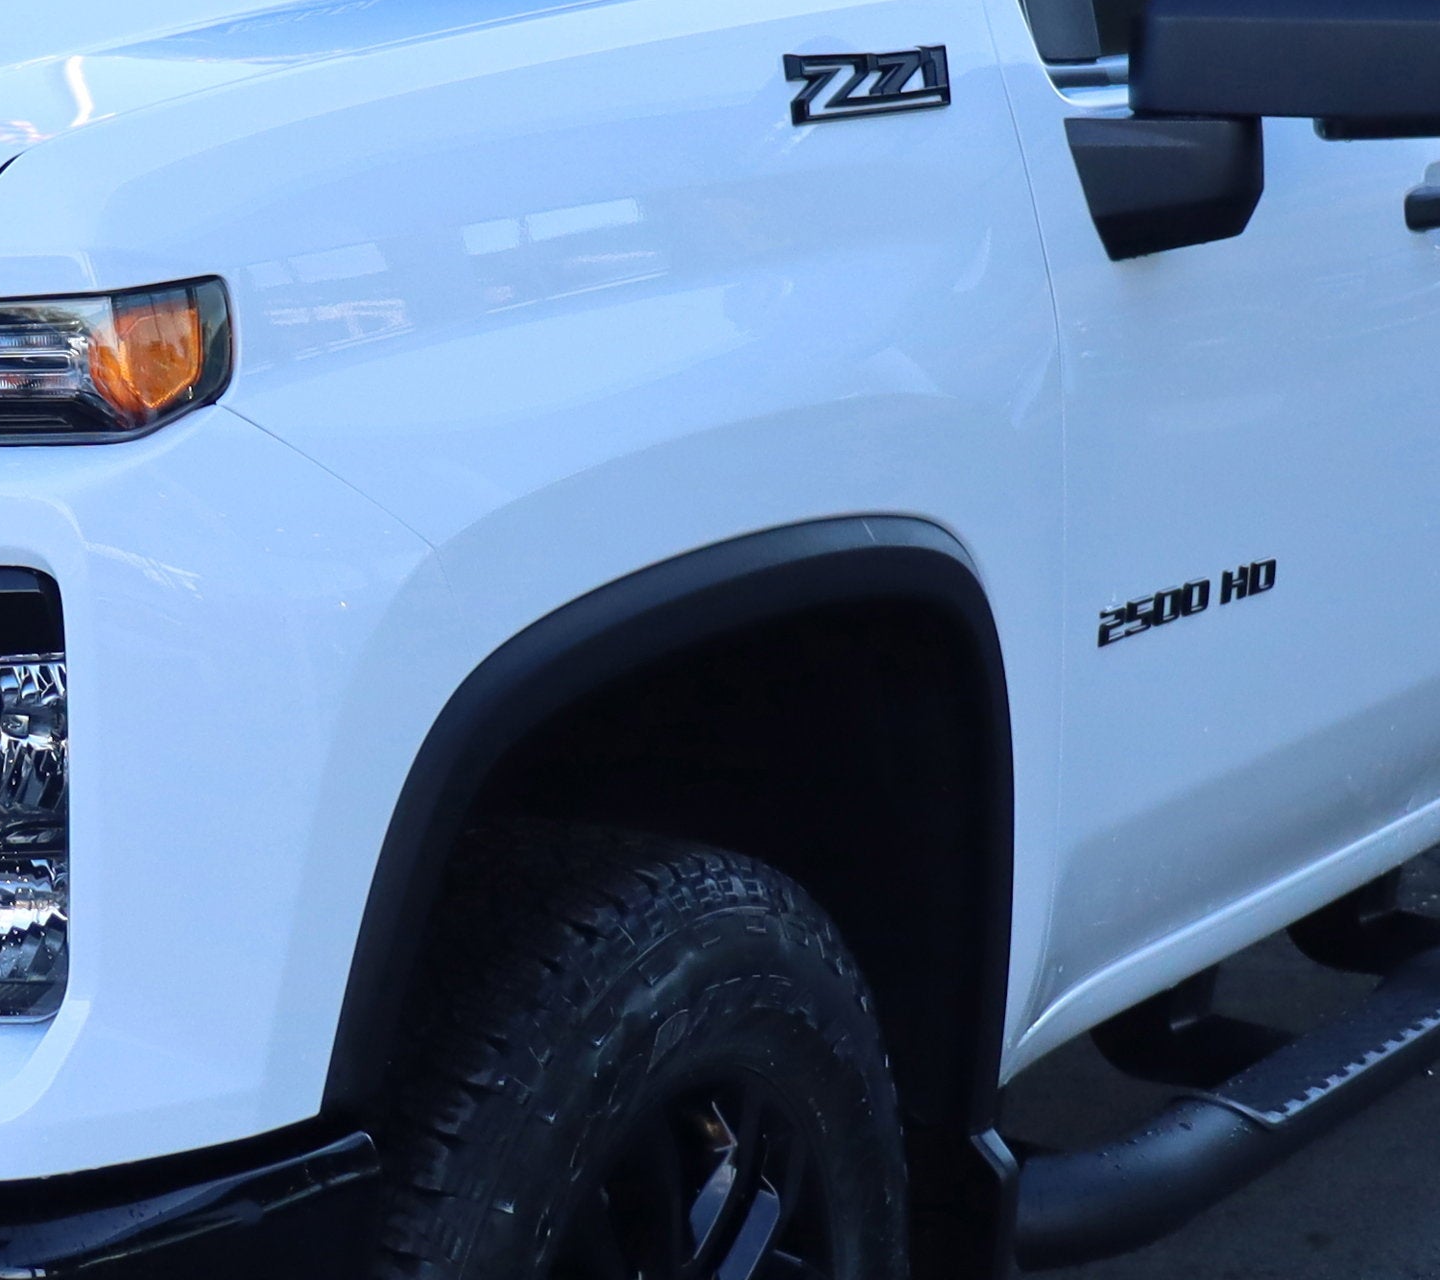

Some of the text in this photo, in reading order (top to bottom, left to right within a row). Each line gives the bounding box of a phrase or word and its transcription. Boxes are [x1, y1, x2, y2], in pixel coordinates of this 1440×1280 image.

[782, 44, 952, 128] Z71
[1097, 557, 1278, 648] 2500 HD
